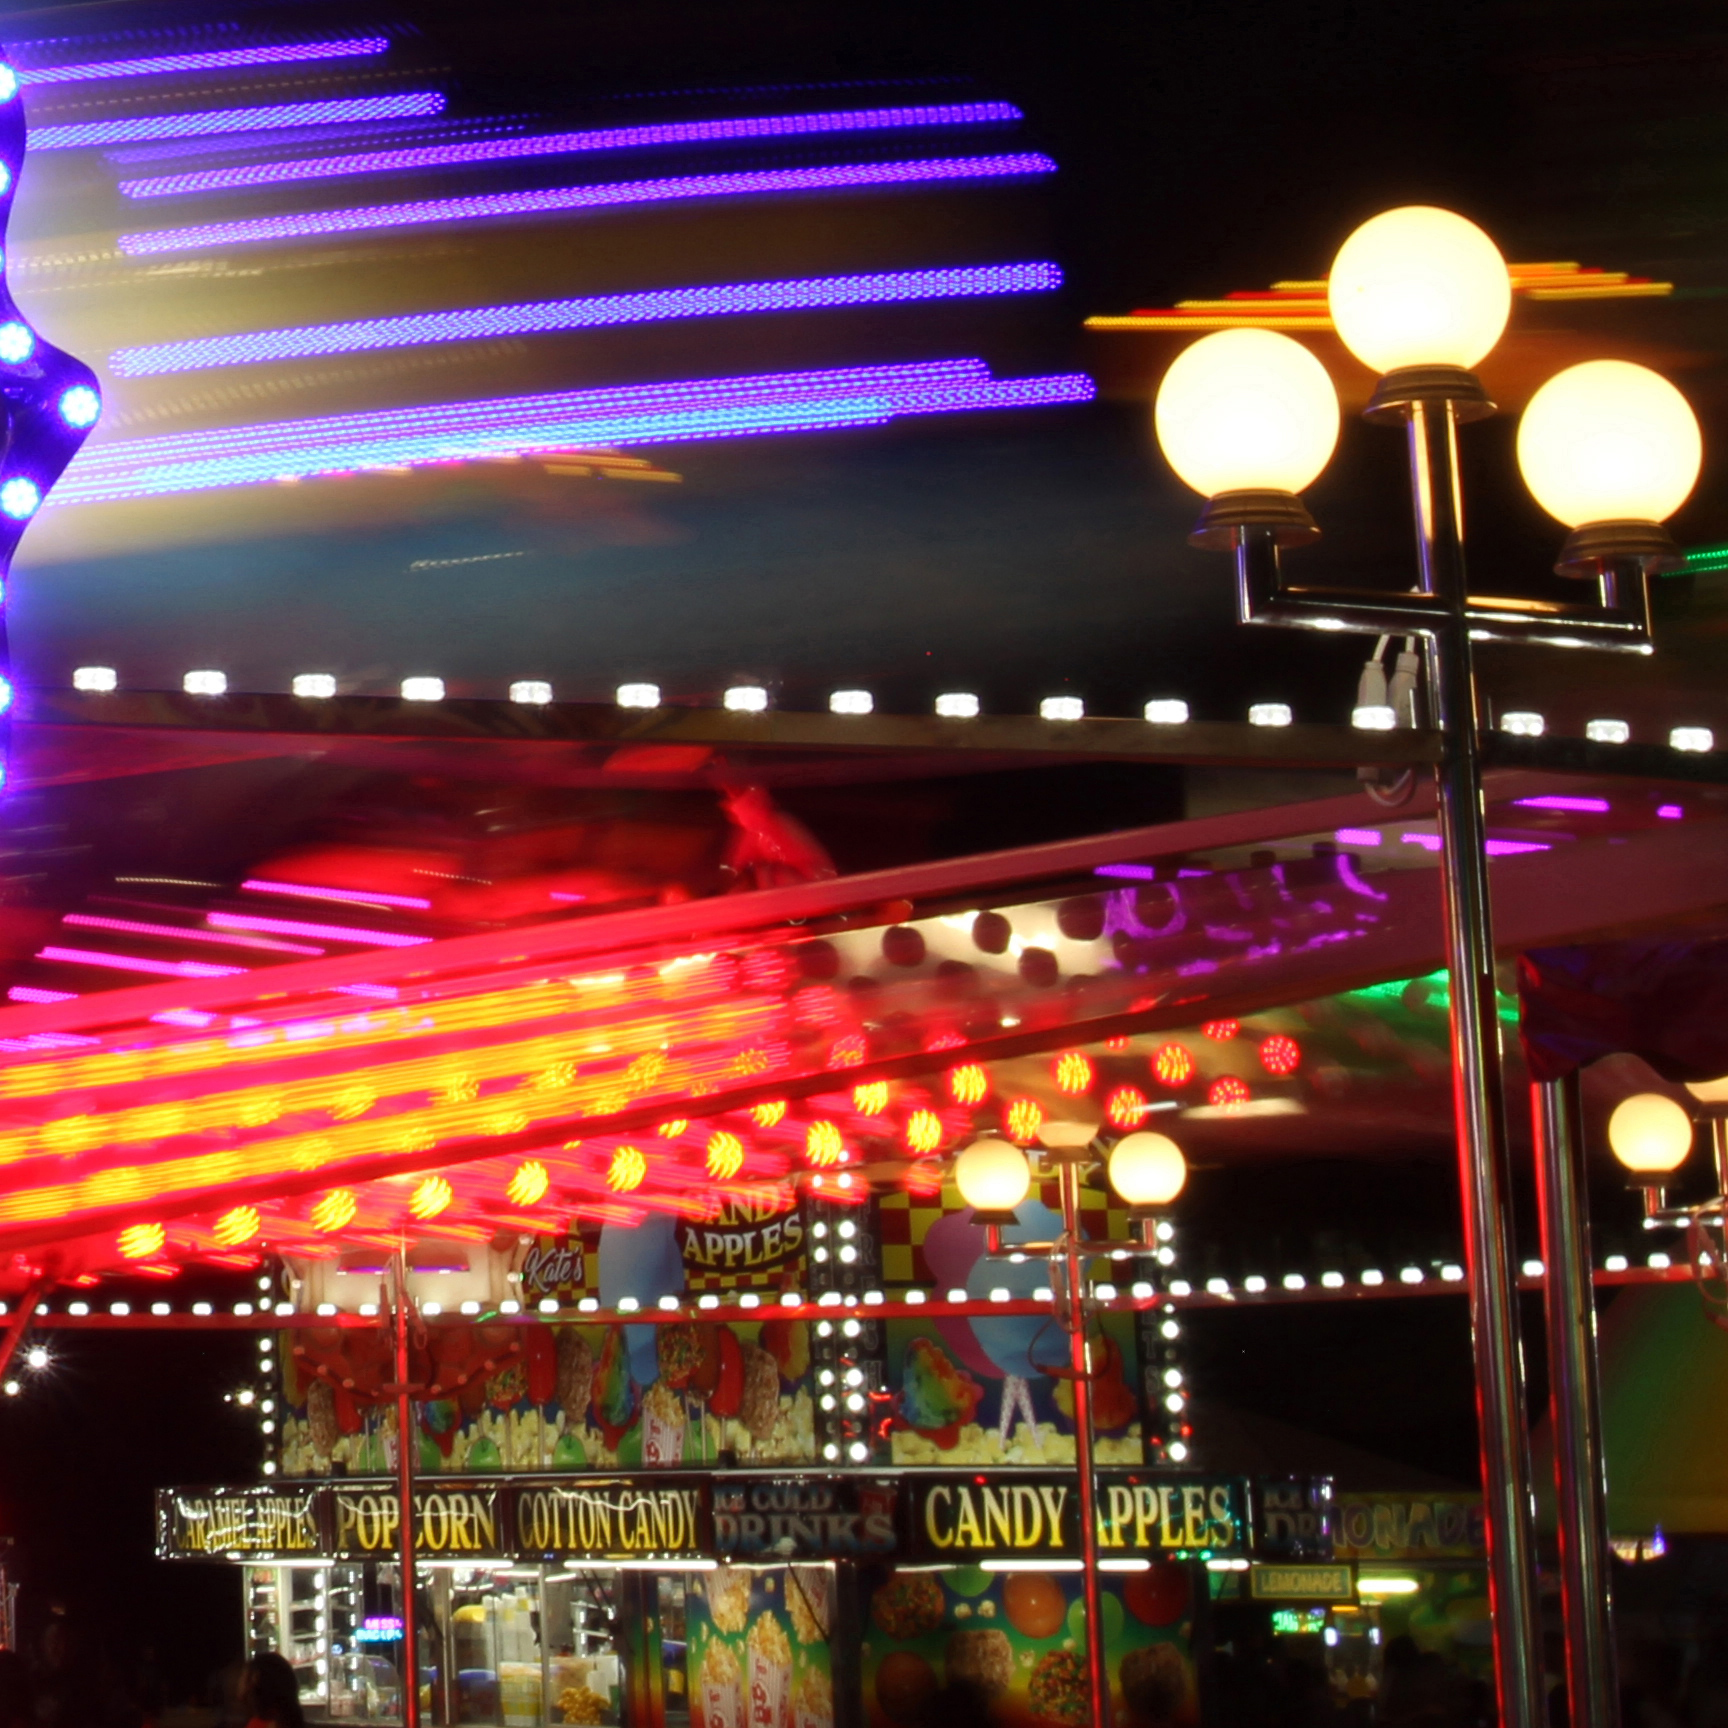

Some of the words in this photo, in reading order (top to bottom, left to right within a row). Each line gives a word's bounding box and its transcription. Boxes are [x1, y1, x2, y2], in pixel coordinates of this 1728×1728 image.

[682, 1213, 804, 1268] APPLES
[524, 1241, 583, 1293] Kate's
[255, 1497, 317, 1550] APPLES
[518, 1491, 611, 1550] COTTON
[619, 1490, 700, 1550] CANDY
[752, 1486, 833, 1512] COLD
[925, 1485, 1068, 1549] CANDY
[1095, 1485, 1237, 1549] APPLES
[713, 1513, 895, 1552] DRINKS
[1261, 1572, 1342, 1593] LEMONADE
